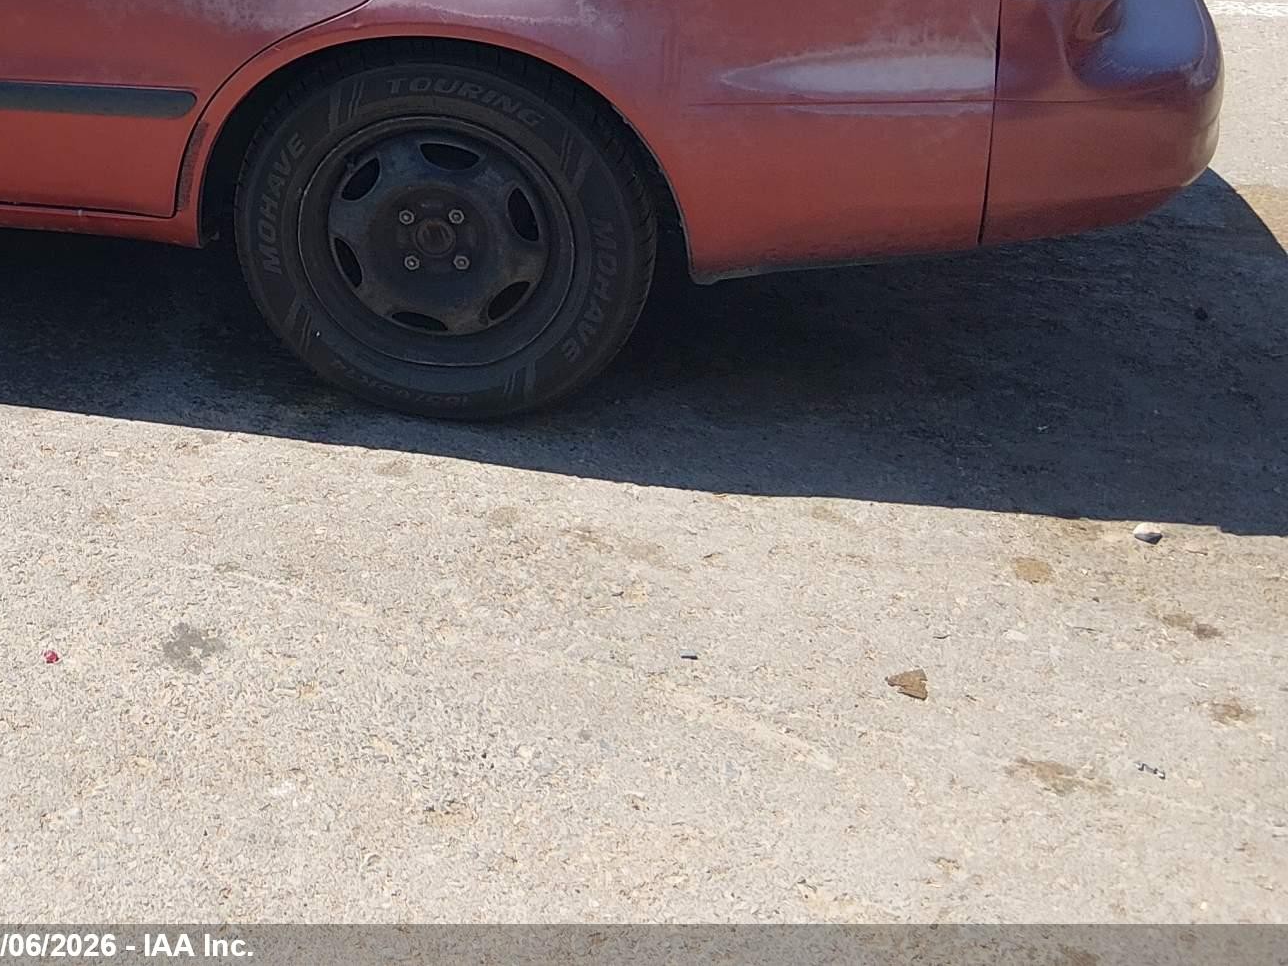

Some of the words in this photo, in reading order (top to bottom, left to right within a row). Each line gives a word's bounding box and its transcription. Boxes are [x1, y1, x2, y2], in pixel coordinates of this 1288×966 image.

[386, 76, 545, 128] TOURING
[261, 131, 307, 276] MOHAVE
[562, 216, 619, 363] MOHAVE
